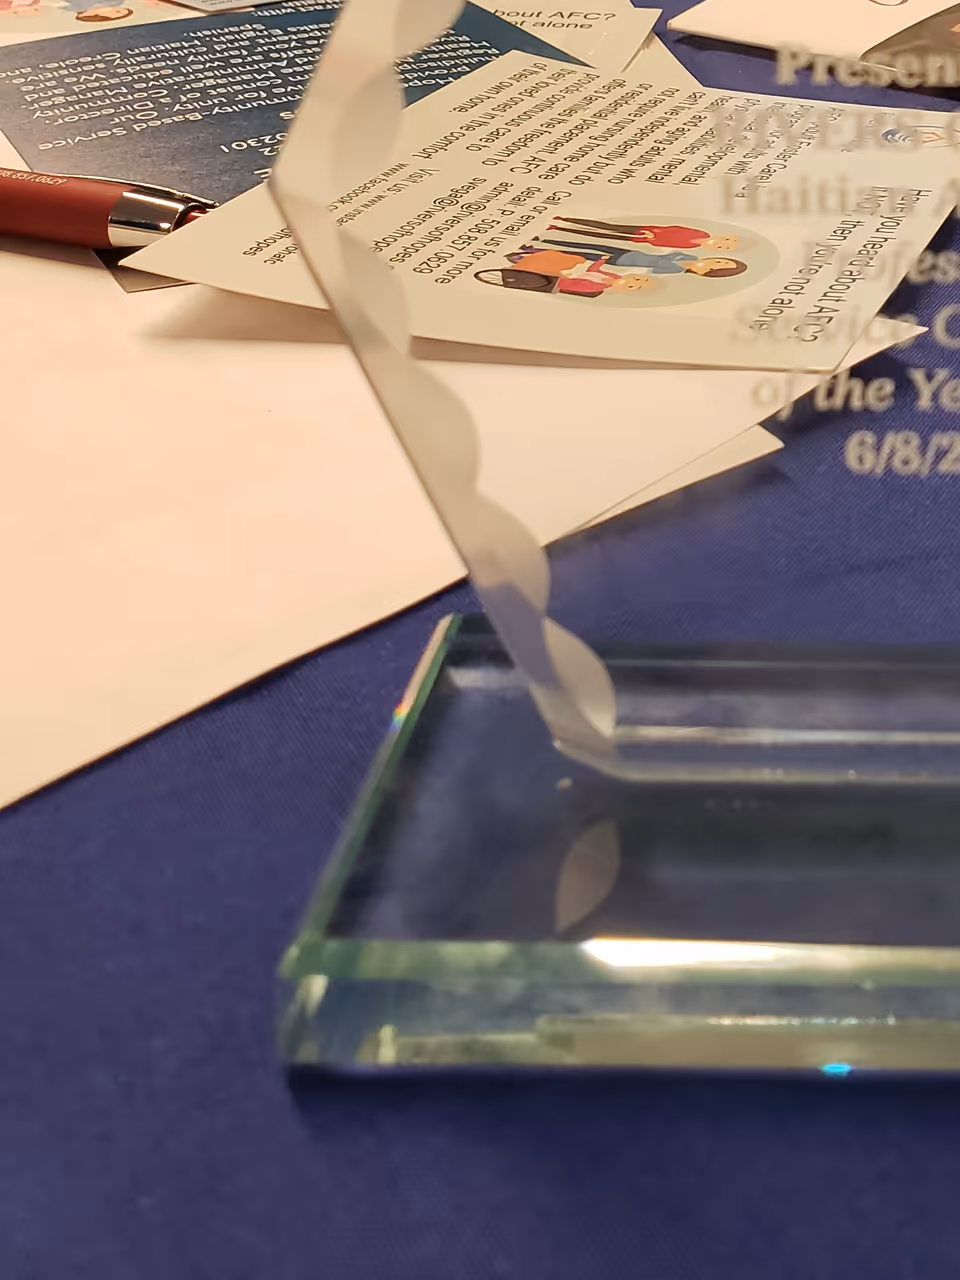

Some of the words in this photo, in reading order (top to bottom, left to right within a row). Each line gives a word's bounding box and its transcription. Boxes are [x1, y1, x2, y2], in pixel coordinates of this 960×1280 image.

[492, 7, 544, 20] bout
[548, 9, 618, 23] AFC?
[531, 19, 594, 31] alone
[126, 39, 202, 55] Haitian
[213, 40, 251, 51] and
[254, 40, 302, 53] your
[113, 43, 208, 66] culturally
[187, 49, 249, 67] family
[229, 54, 264, 64] are
[294, 54, 323, 65] nd
[109, 58, 180, 74] needs.
[132, 59, 288, 89] Administrative
[179, 61, 226, 74] well
[279, 64, 313, 74] ase
[526, 62, 548, 72] of
[63, 72, 107, 83] We
[72, 69, 174, 93] educated
[507, 68, 541, 83] their
[546, 68, 577, 82] their
[558, 72, 601, 95] provide
[20, 80, 58, 92] are
[206, 78, 283, 95] consist
[483, 81, 514, 95] own
[517, 80, 558, 99] loved
[593, 78, 627, 95] offers
[636, 83, 654, 91] or
[656, 87, 681, 98] not
[21, 86, 128, 110] Manager.
[23, 88, 66, 102] and
[179, 92, 201, 102] of
[234, 90, 267, 101] for
[448, 93, 496, 113] home.
[678, 91, 707, 106] can't
[32, 89, 169, 119] Community
[491, 96, 525, 113] ones
[504, 93, 566, 128] continuous
[590, 89, 644, 121] residential
[627, 96, 667, 118] require
[664, 105, 693, 117] live
[109, 110, 159, 125] Our
[132, 94, 303, 132] mmunity-Based
[478, 111, 504, 120] in
[682, 114, 708, 128] and
[459, 119, 491, 132] the
[539, 117, 569, 129] the
[588, 117, 636, 142] nursing
[38, 127, 128, 150] Service
[478, 127, 512, 144] care
[493, 128, 552, 158] freedom
[597, 116, 677, 162] independently
[653, 127, 691, 146] aging
[411, 131, 466, 160] comfort
[465, 143, 491, 152] to
[563, 141, 607, 163] home
[481, 157, 508, 166] to
[509, 155, 547, 175] AFC
[628, 145, 667, 168] adults
[400, 168, 441, 184] Visit
[537, 162, 571, 180] care
[581, 161, 616, 175] but
[644, 157, 687, 184] mental
[724, 160, 753, 175] with
[568, 174, 595, 186] do
[607, 168, 639, 185] who
[328, 162, 410, 213] www.facebook.c
[540, 190, 573, 206] Call
[336, 194, 389, 227] www.insta
[372, 177, 488, 253] svega@riversofhope
[489, 208, 516, 218] P:
[529, 205, 548, 215] or
[499, 214, 536, 237] email
[826, 220, 866, 242] then
[874, 215, 907, 234] you
[412, 218, 502, 274] 508.857.0629
[483, 236, 508, 247] us
[263, 243, 304, 265] ohafc
[466, 248, 497, 261] for
[847, 236, 897, 268] heard
[434, 260, 475, 284] more
[777, 277, 812, 296] not
[817, 269, 865, 303] about
[749, 367, 801, 421] of
[812, 369, 897, 414] the
